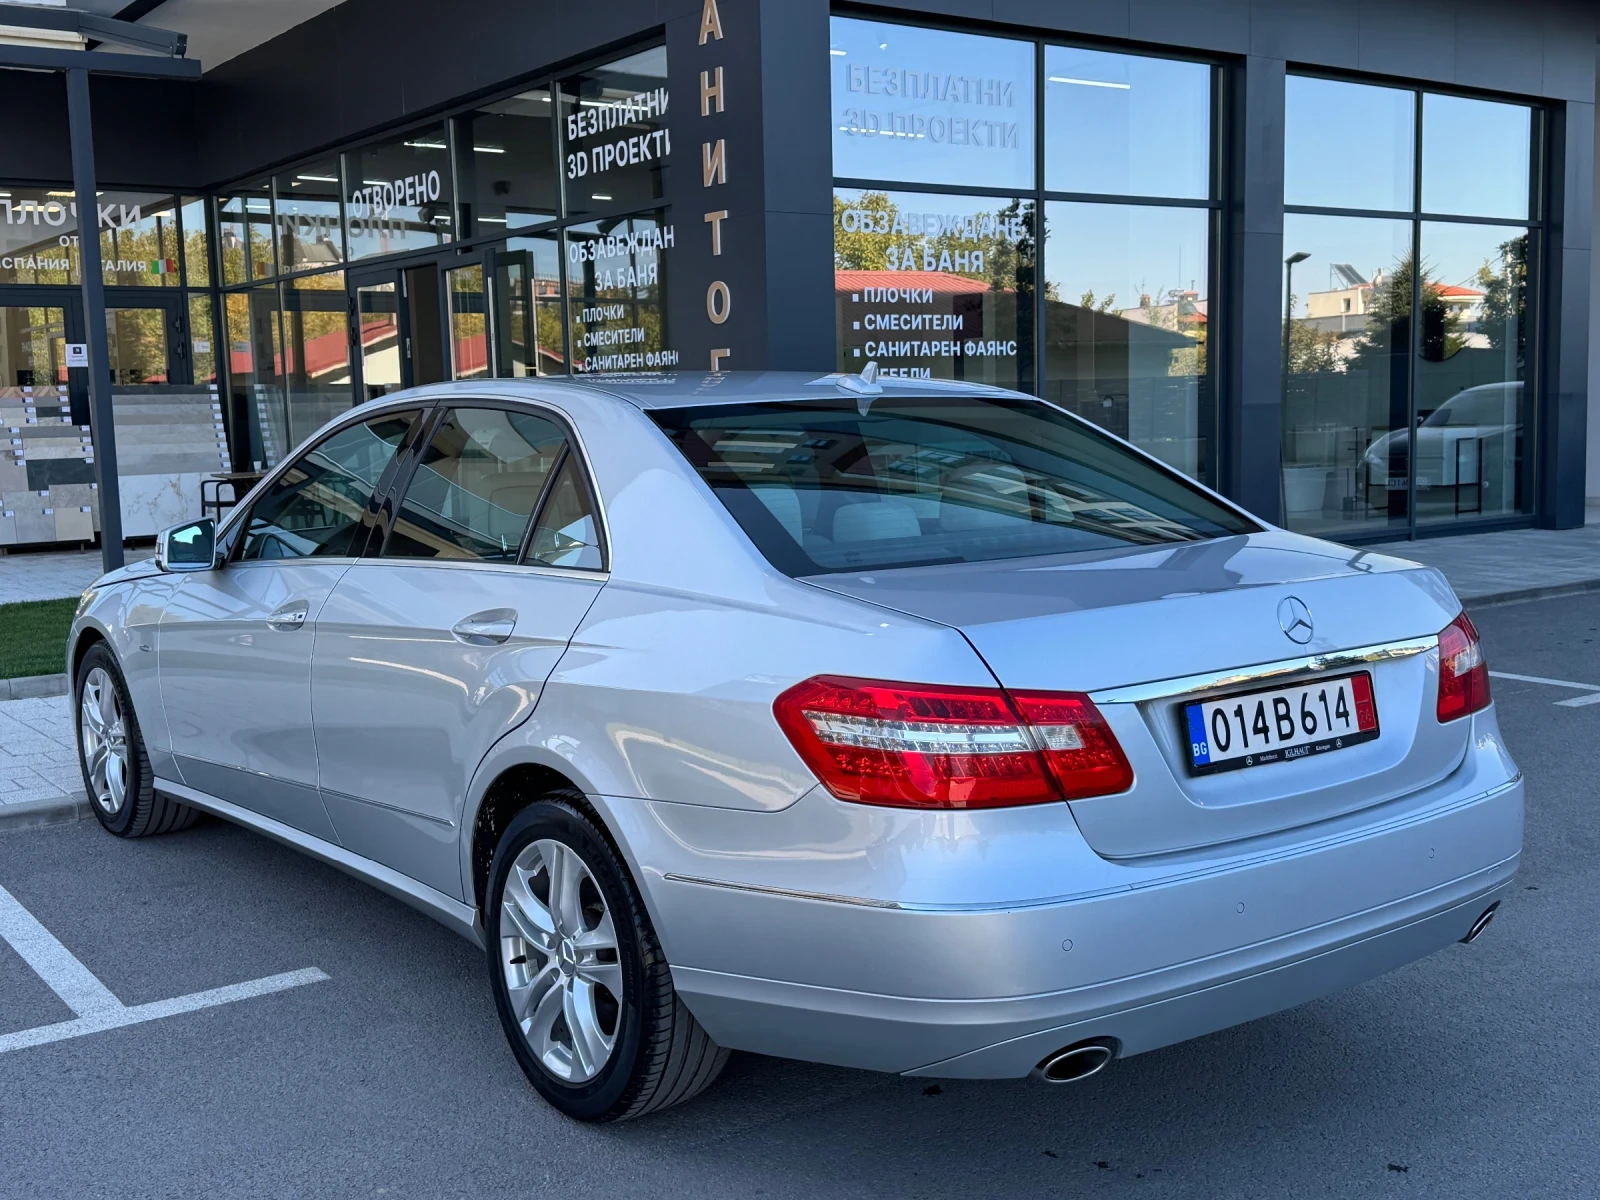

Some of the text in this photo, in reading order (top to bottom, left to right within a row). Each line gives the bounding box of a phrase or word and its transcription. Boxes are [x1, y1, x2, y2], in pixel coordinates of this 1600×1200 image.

[846, 63, 1015, 108] БЕЗПЛАТНИ
[842, 108, 1019, 149] 3D ПРОЕКТИ
[567, 151, 588, 180] 3D
[351, 169, 441, 219] ОТВОРЕНО
[841, 208, 1022, 243] ОБЗАВЕЖДАНЕ
[0, 256, 70, 271] СПАНИЯ
[923, 248, 984, 273] БАНЯ
[617, 262, 658, 289] БАНЯ
[863, 286, 933, 304] ПЛОЧКИ
[582, 304, 625, 323] ПЛОЧКИ
[864, 314, 963, 331] СМЕСИТЕЛИ
[583, 327, 645, 347] СМЕСИТЕЛИ
[864, 341, 1017, 357] САНИТАРЕН ФАЯНС
[584, 353, 643, 372] САНИТАРЕН
[1211, 686, 1350, 752] 014B614
[1192, 741, 1209, 758] BG
